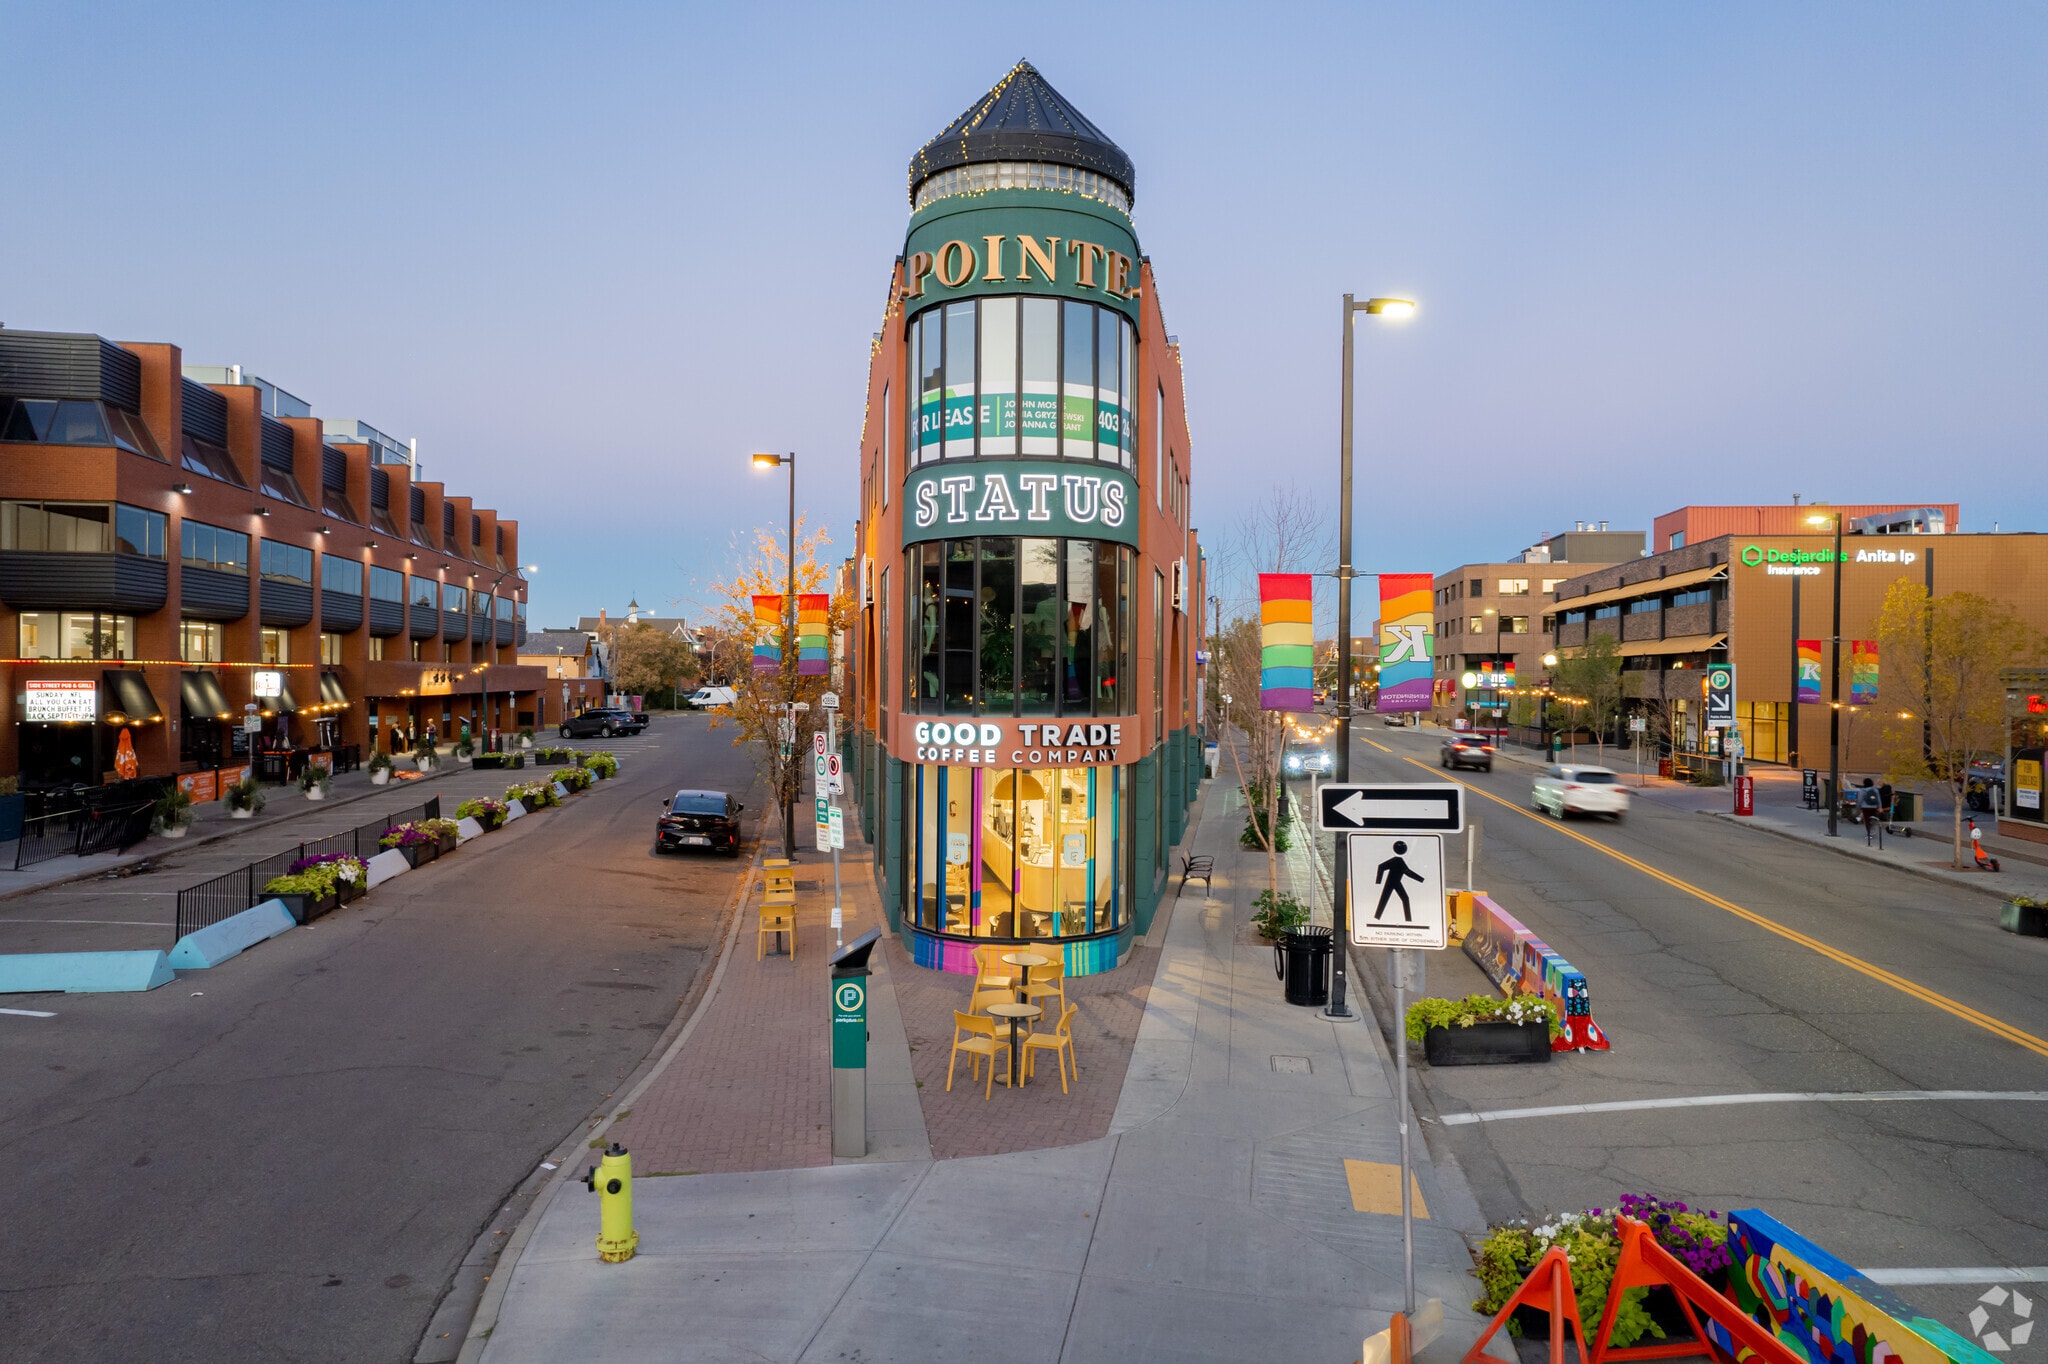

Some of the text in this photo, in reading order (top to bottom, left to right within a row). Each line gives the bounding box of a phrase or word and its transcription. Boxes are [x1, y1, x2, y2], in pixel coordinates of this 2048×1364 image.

[907, 234, 1133, 300] POINTE
[1005, 400, 1035, 408] JOHN
[932, 406, 990, 430] LEASE
[1005, 420, 1048, 429] JOANNA
[1098, 410, 1119, 432] 403
[915, 474, 1124, 527] STATUS
[1855, 549, 1896, 562] Anita
[1899, 549, 1916, 564] Ip
[1767, 565, 1821, 577] Insurance
[915, 721, 1121, 747] GOOD TRADE
[917, 746, 1118, 763] COFFEE COMPANY
